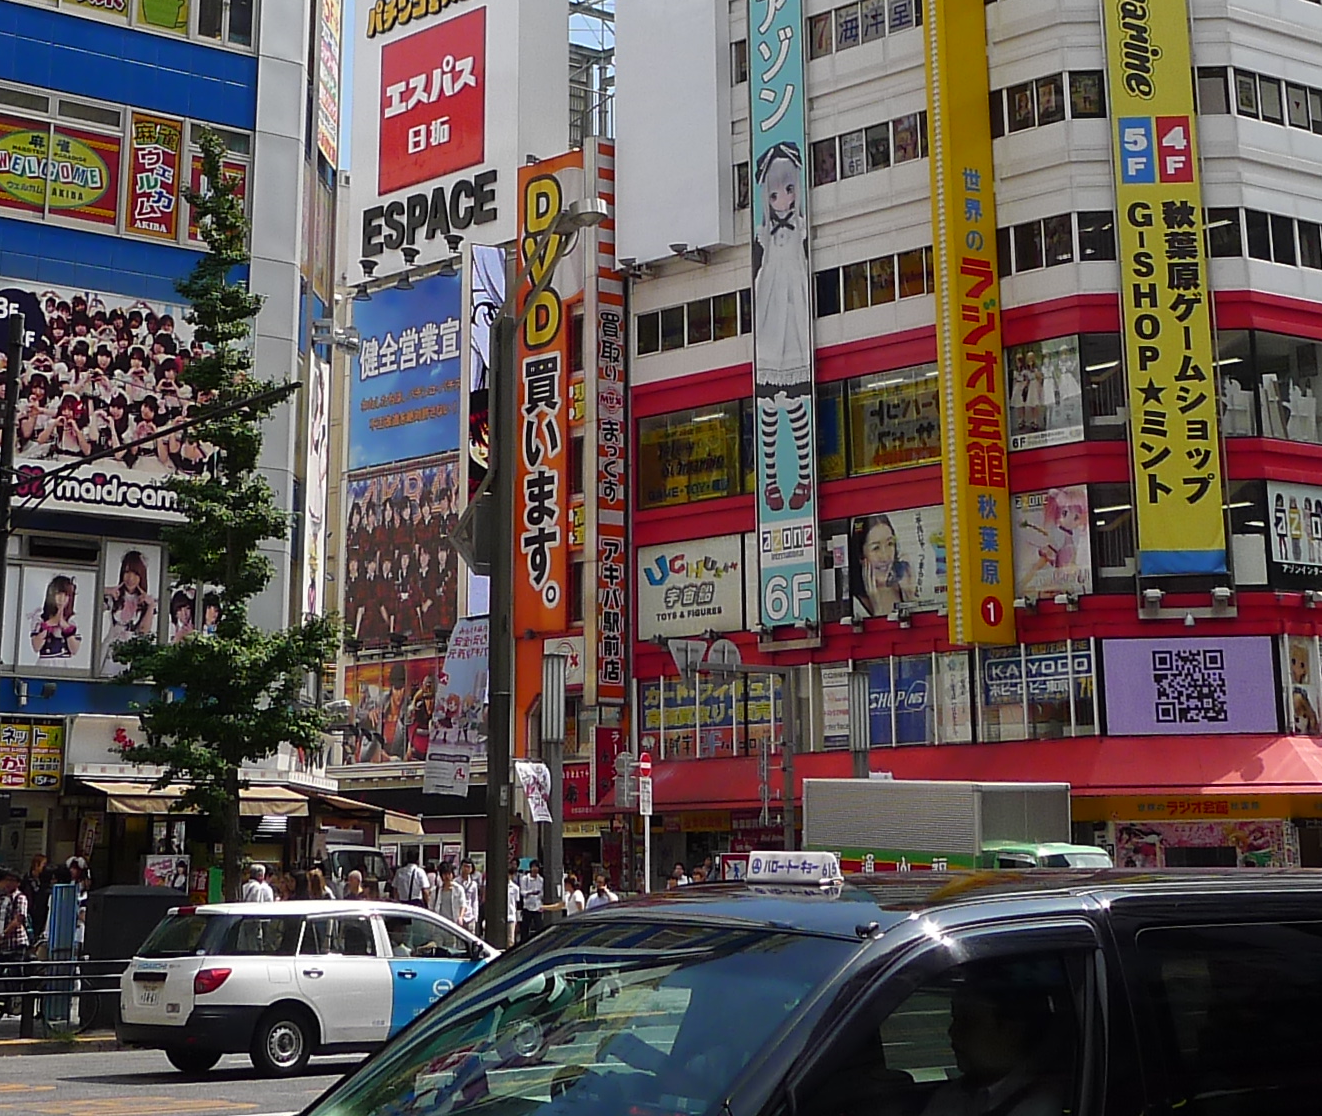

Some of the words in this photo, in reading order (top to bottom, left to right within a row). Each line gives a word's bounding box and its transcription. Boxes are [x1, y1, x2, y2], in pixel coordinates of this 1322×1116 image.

[384, 55, 476, 120] エスパス
[407, 115, 451, 155] 日拓
[51, 186, 84, 203] AKIBA
[134, 220, 169, 234] AKIBA
[362, 168, 499, 258] ESPACE
[961, 167, 984, 252] 世界の
[597, 309, 624, 384] 買取り
[959, 257, 1007, 488] ラジオ会館
[1160, 199, 1216, 506] 秋葉原ゲームショップ
[521, 356, 561, 610] 買います。
[976, 493, 1000, 586] 秋葉原
[600, 534, 624, 685] アキバ駅前店
[656, 610, 678, 622] TOYS
[687, 605, 723, 620] FIGURES
[664, 582, 715, 607] 宇宙船
[763, 571, 815, 622] 6F
[1165, 800, 1229, 816] ラジオ会館
[821, 861, 838, 877] 615
